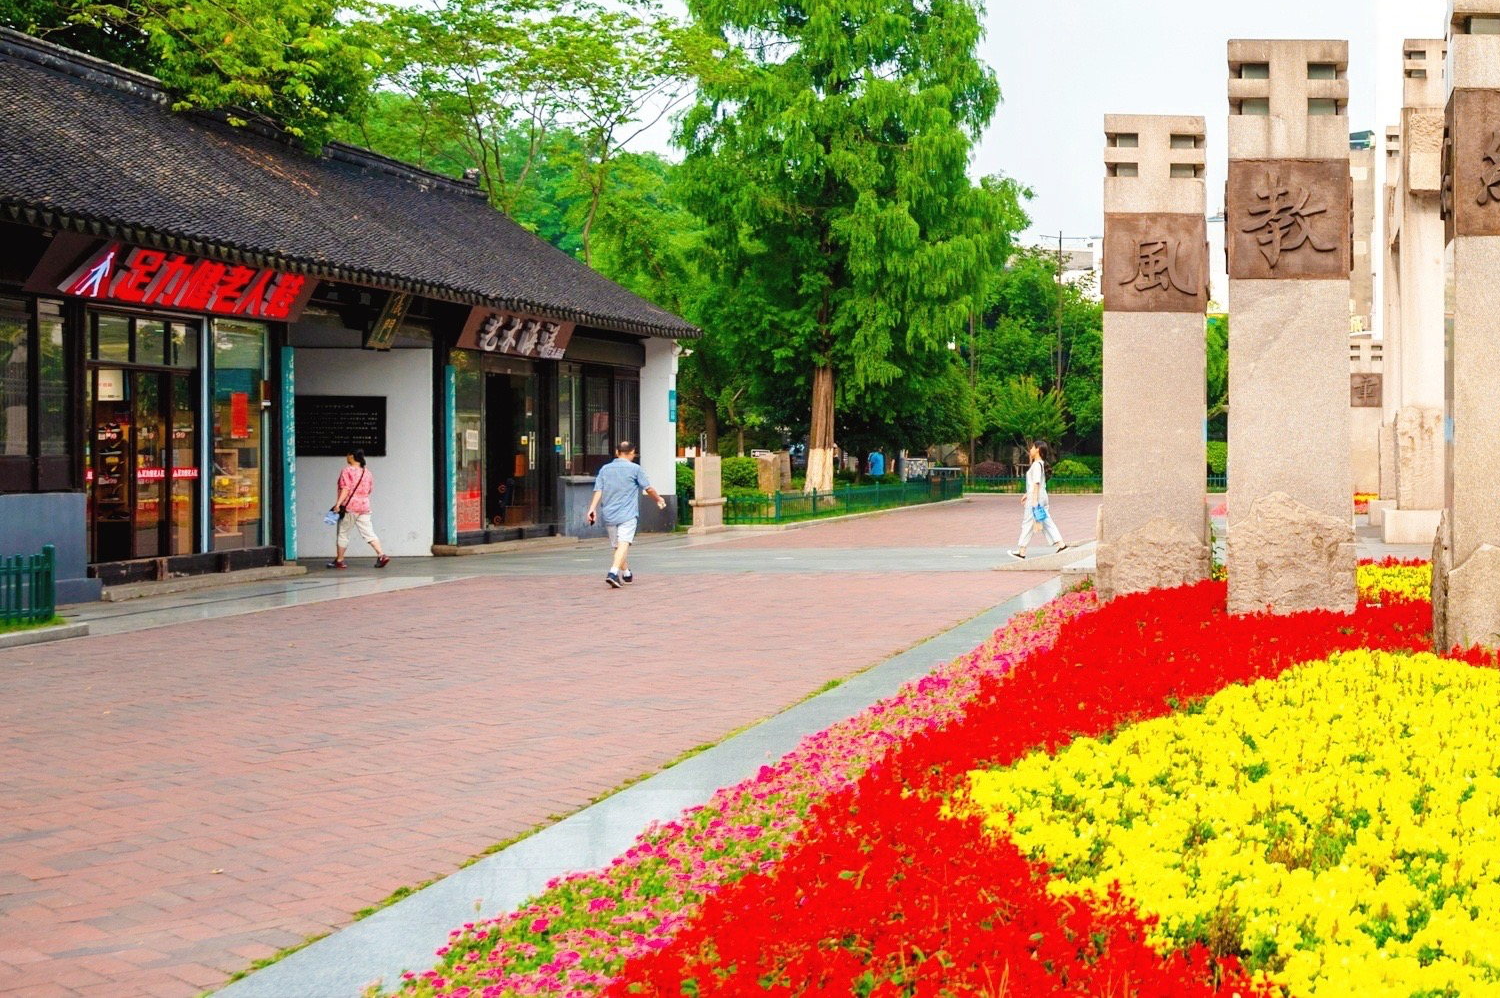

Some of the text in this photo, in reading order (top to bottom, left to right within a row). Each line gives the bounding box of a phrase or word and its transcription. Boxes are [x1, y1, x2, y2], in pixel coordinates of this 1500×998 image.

[1242, 170, 1337, 270] 教
[110, 247, 305, 319] 足力健老人鞋
[1119, 237, 1199, 296] 風
